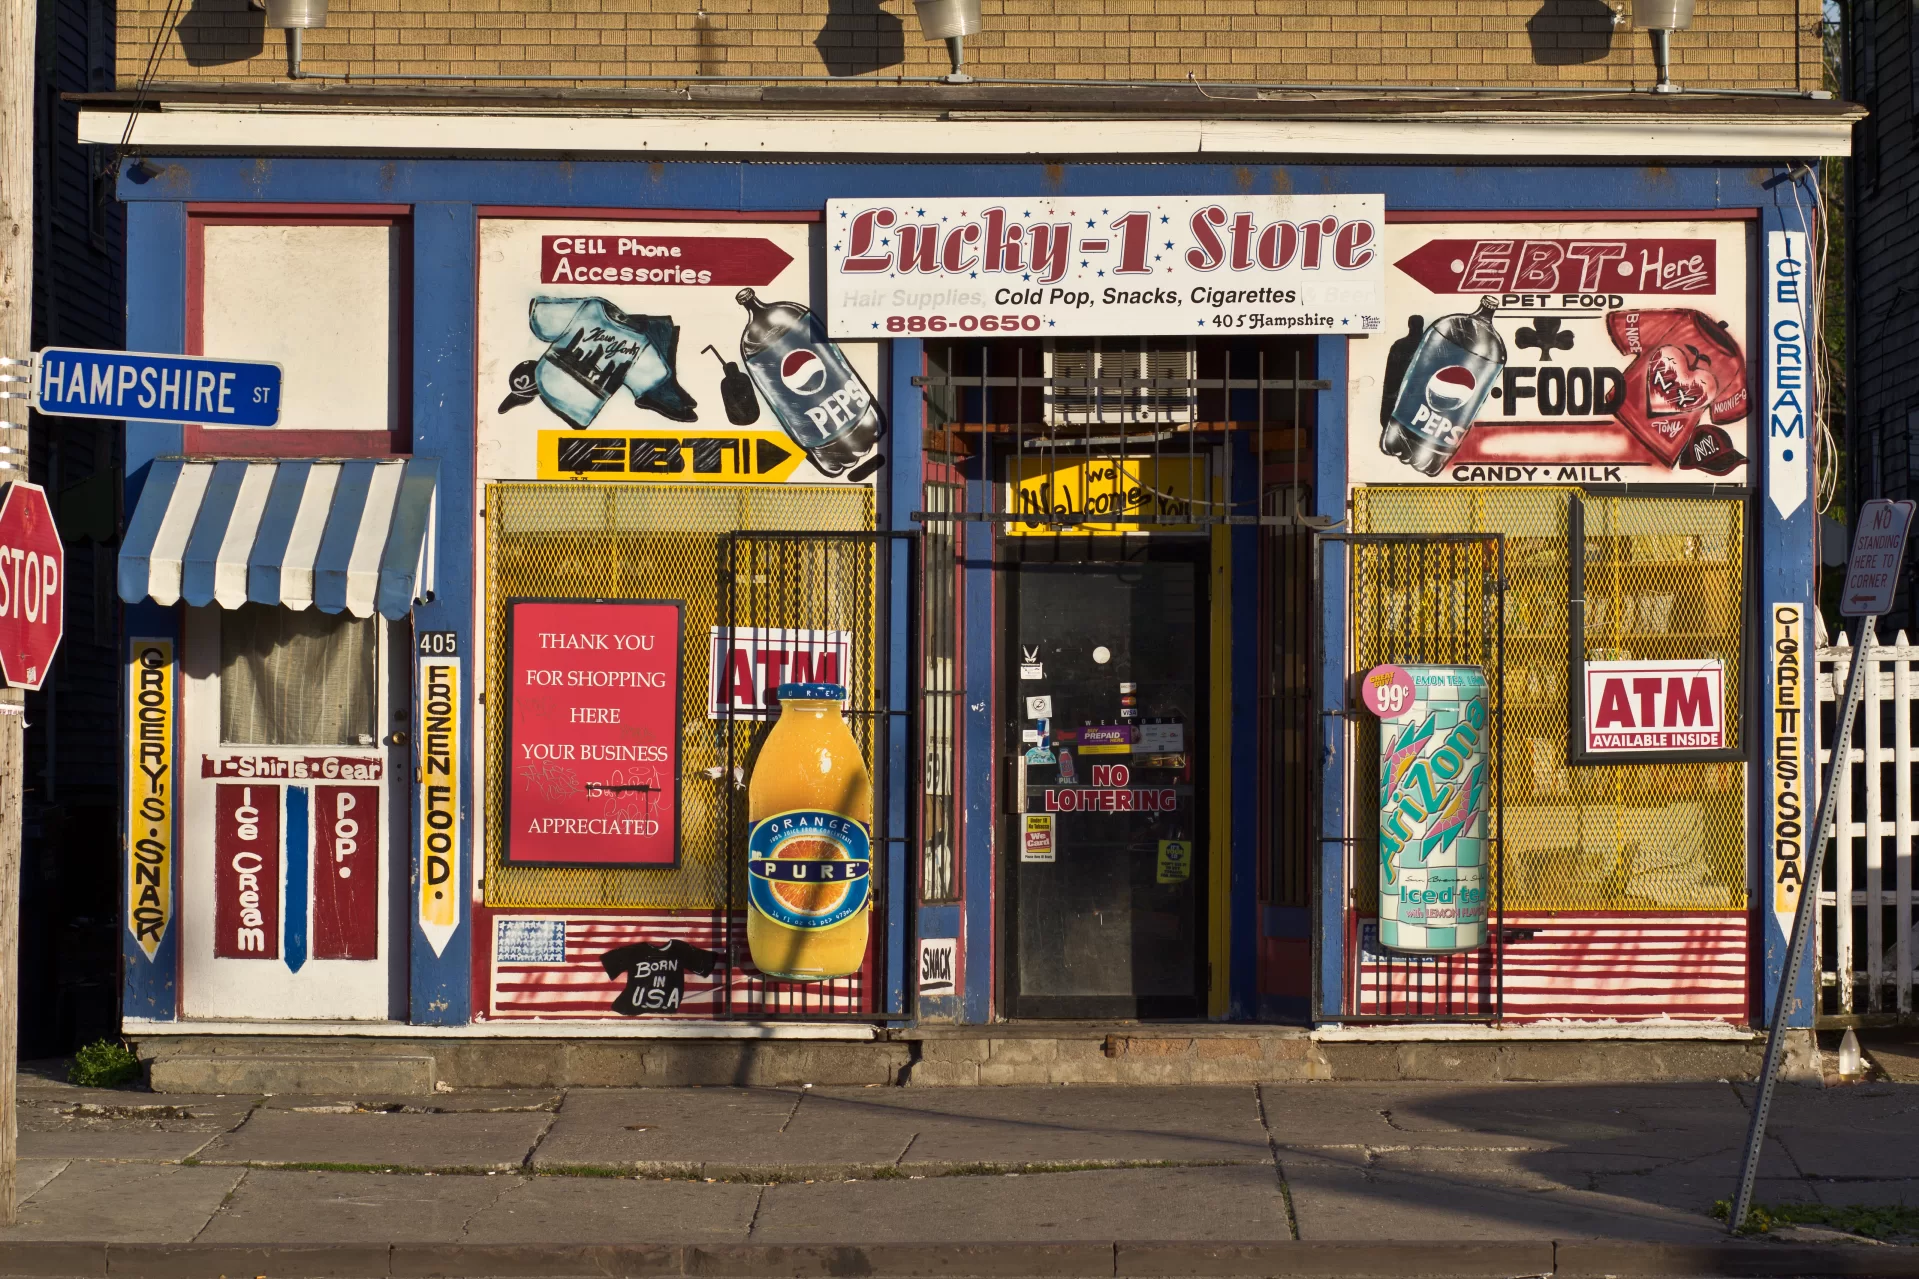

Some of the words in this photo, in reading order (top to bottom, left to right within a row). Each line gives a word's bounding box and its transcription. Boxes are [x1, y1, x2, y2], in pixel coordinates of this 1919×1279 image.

[552, 237, 606, 255] CELL
[618, 237, 682, 258] Phone
[840, 203, 1154, 285] Lucky-1
[1185, 203, 1378, 272] Store
[553, 257, 712, 285] Accessories
[1457, 239, 1627, 294] EBT
[1639, 246, 1705, 291] Here
[1776, 237, 1802, 304] ICE
[843, 290, 888, 307] Hair
[892, 288, 987, 310] Supplies,
[994, 288, 1044, 305] Cold
[1049, 287, 1095, 308] Pop,
[1102, 286, 1182, 307] Snacks,
[1190, 286, 1297, 308] Cigarettes
[1501, 294, 1551, 308] PET
[1562, 293, 1624, 309] FOOD
[886, 314, 1041, 333] 886-0650
[1248, 313, 1334, 329] Hampshire
[43, 360, 236, 414] HAMPSHIRE
[252, 386, 271, 404] ST
[1771, 319, 1804, 439] CREAM
[1503, 366, 1627, 417] FOOD
[1452, 466, 1538, 482] CANDY
[1557, 466, 1622, 482] MILK
[1872, 509, 1893, 531] NO
[1857, 535, 1901, 550] STANDING
[1853, 555, 1879, 569] HERE
[1882, 554, 1895, 569] TO
[0, 544, 58, 625] STOP
[1850, 574, 1888, 589] CORNER
[420, 633, 457, 653] 405
[539, 633, 609, 650] THANK
[613, 634, 656, 651] YOU
[526, 670, 564, 686] FOR
[567, 670, 666, 688] SHOPPING
[716, 648, 839, 706] ATM
[1595, 677, 1714, 728] ATM
[1775, 607, 1801, 780] CIGARETTES
[426, 665, 452, 775] FROZEN
[570, 707, 621, 724] HERE
[139, 647, 167, 822] GROCERY'S
[1084, 732, 1121, 740] PREPAID
[1593, 734, 1668, 747] AVAILABLE
[1671, 733, 1719, 746] INSIDE
[521, 743, 576, 760] YOUR
[580, 744, 669, 762] BUSINESS
[322, 757, 381, 780] Gear
[1092, 764, 1130, 787] NO
[586, 781, 603, 798] IS
[1058, 777, 1077, 785] PULL
[1045, 788, 1177, 812] LOITERING
[427, 785, 453, 885] FOOD
[527, 817, 659, 836] APPRECIATED
[771, 816, 851, 834] ORANGE
[1026, 839, 1050, 847] Card
[1030, 832, 1047, 840] We
[1776, 791, 1801, 884] SODA
[765, 862, 856, 879] PURE
[135, 838, 167, 943] SNACK
[1400, 886, 1454, 904] Iced
[1406, 908, 1424, 918] with
[1425, 907, 1460, 918] LEMON
[921, 946, 952, 980] SNACK
[653, 975, 666, 988] IN
